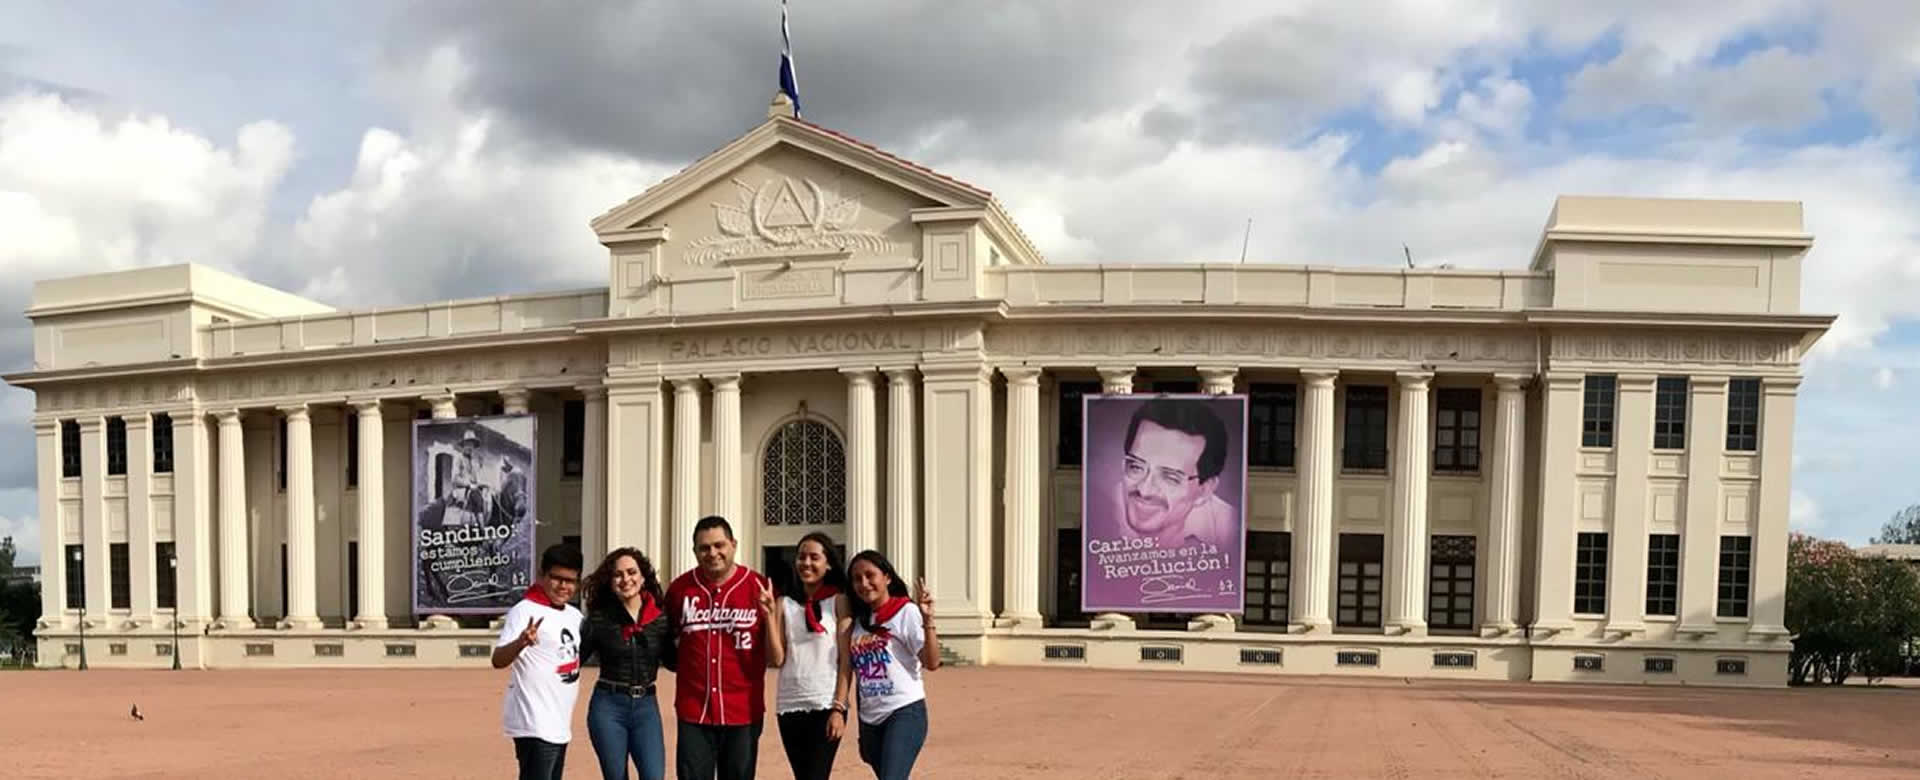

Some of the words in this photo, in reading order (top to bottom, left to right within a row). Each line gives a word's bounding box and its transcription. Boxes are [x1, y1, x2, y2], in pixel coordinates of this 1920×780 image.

[669, 336, 771, 360] PALACIO
[786, 332, 911, 354] NACIONAL
[420, 523, 515, 547] Sandino:
[1088, 535, 1160, 554] Carlos:
[420, 546, 478, 560] estamos
[1098, 549, 1176, 565] Avanzamos
[1178, 545, 1198, 557] en
[1201, 542, 1218, 555] la
[1103, 553, 1231, 579] Revolución!
[680, 595, 757, 634] Nicaragua
[733, 631, 752, 649] 12
